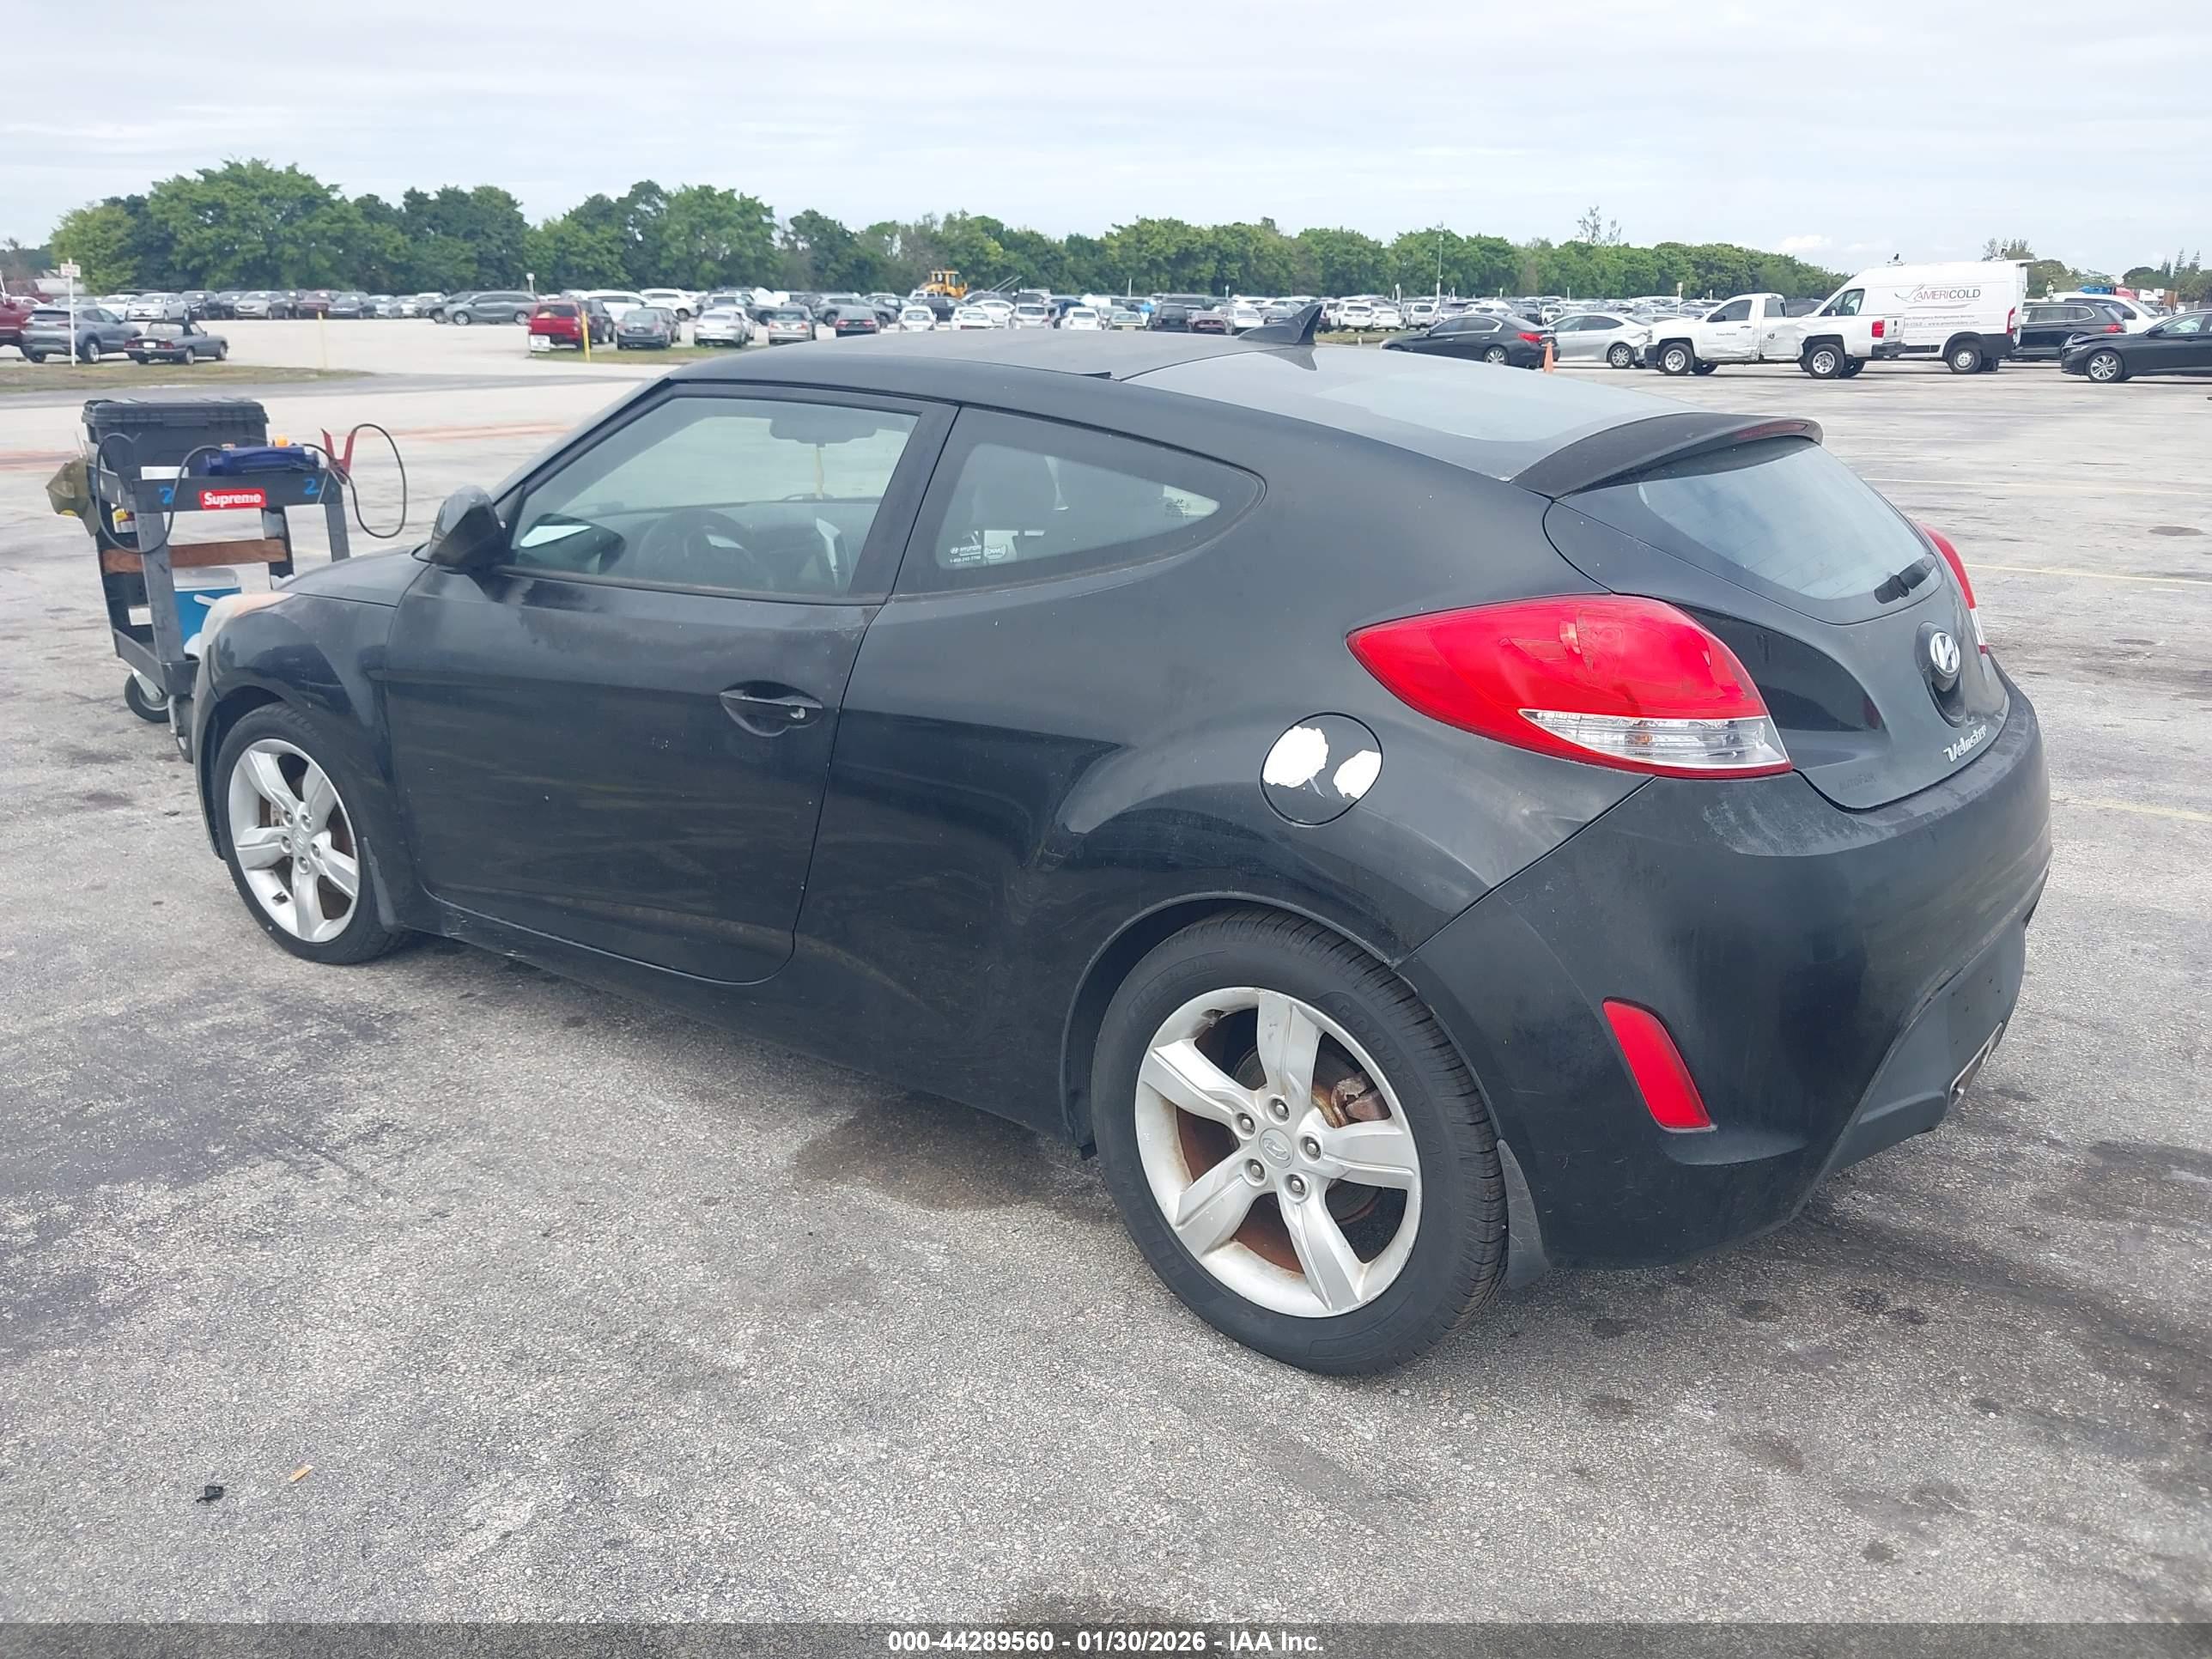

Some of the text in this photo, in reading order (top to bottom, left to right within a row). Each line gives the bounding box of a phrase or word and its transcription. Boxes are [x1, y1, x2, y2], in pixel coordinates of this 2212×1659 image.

[1915, 289, 1981, 301] AMERICOLD
[204, 491, 262, 508] Supreme
[1942, 724, 1987, 763] Veloster
